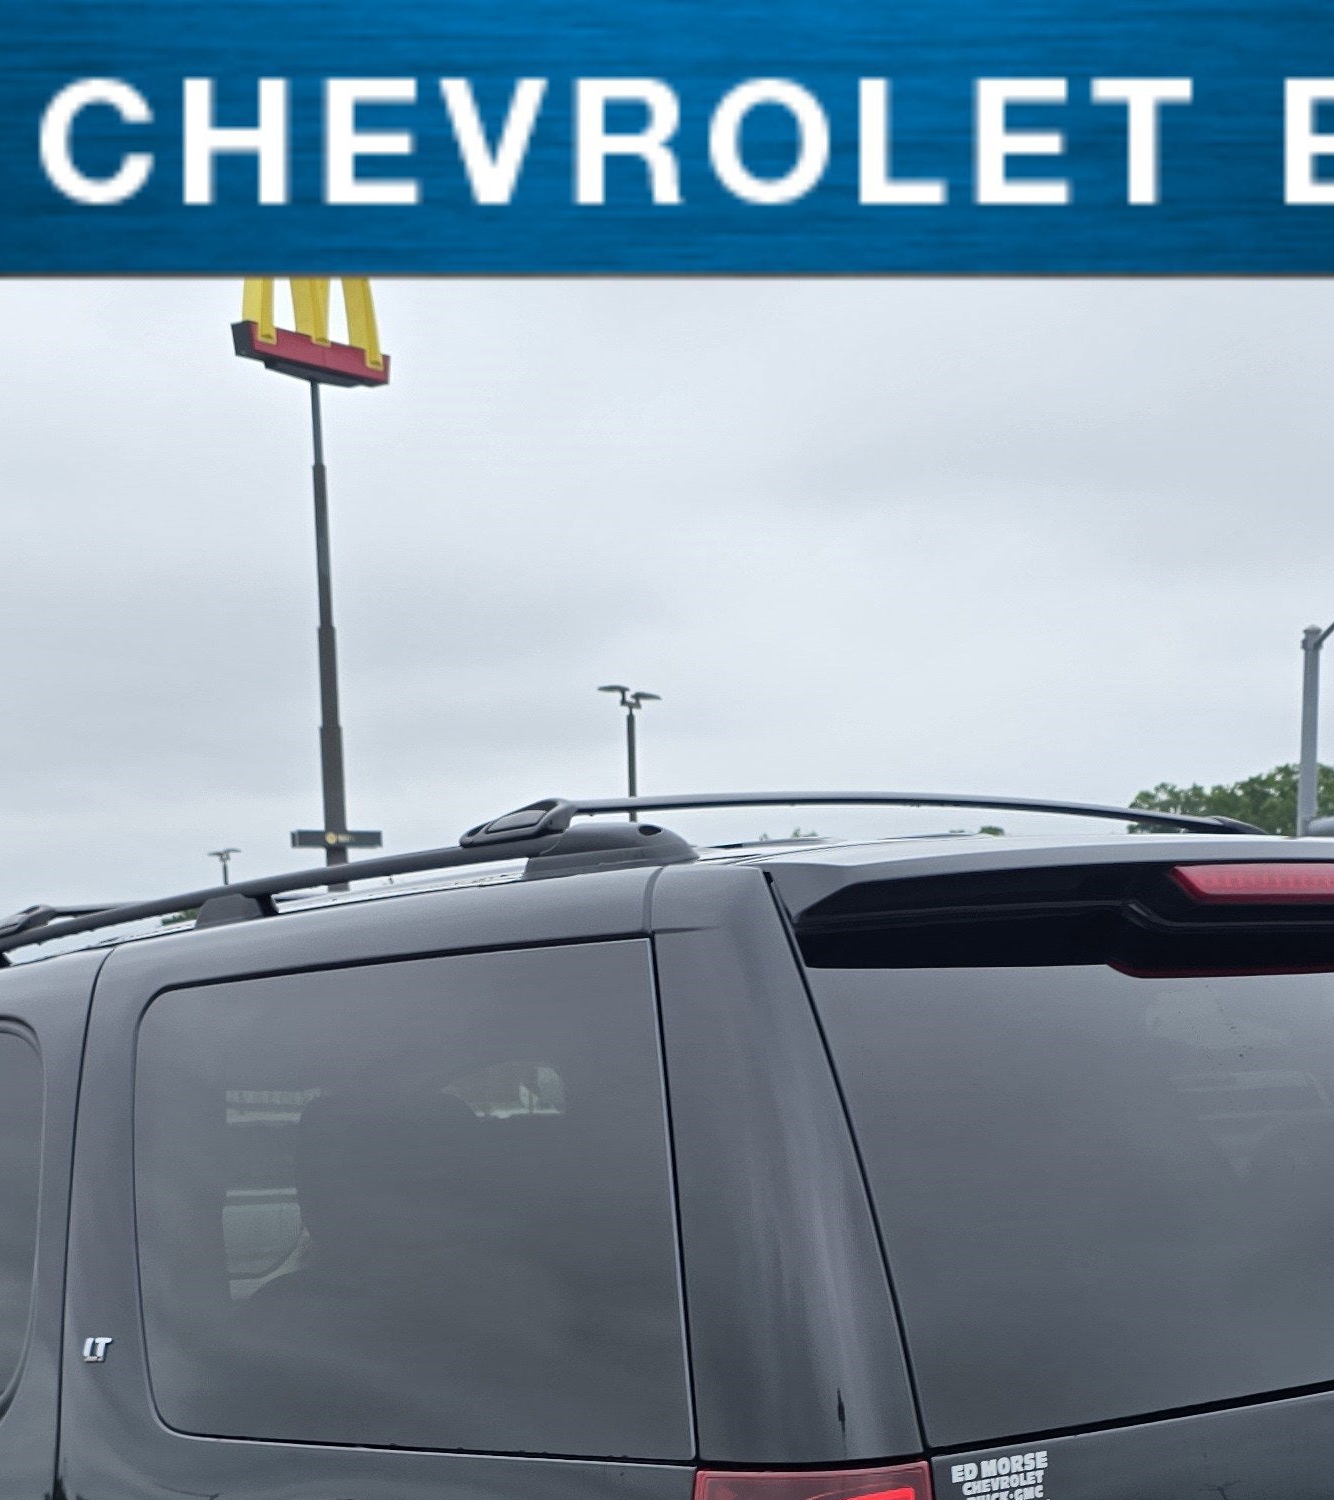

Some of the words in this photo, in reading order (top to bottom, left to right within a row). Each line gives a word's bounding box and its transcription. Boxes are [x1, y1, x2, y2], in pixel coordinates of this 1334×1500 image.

[82, 1336, 113, 1362] LT
[951, 1463, 979, 1484] ED
[980, 1450, 1048, 1478] MORSE
[962, 1469, 1044, 1496] CHEVROLET
